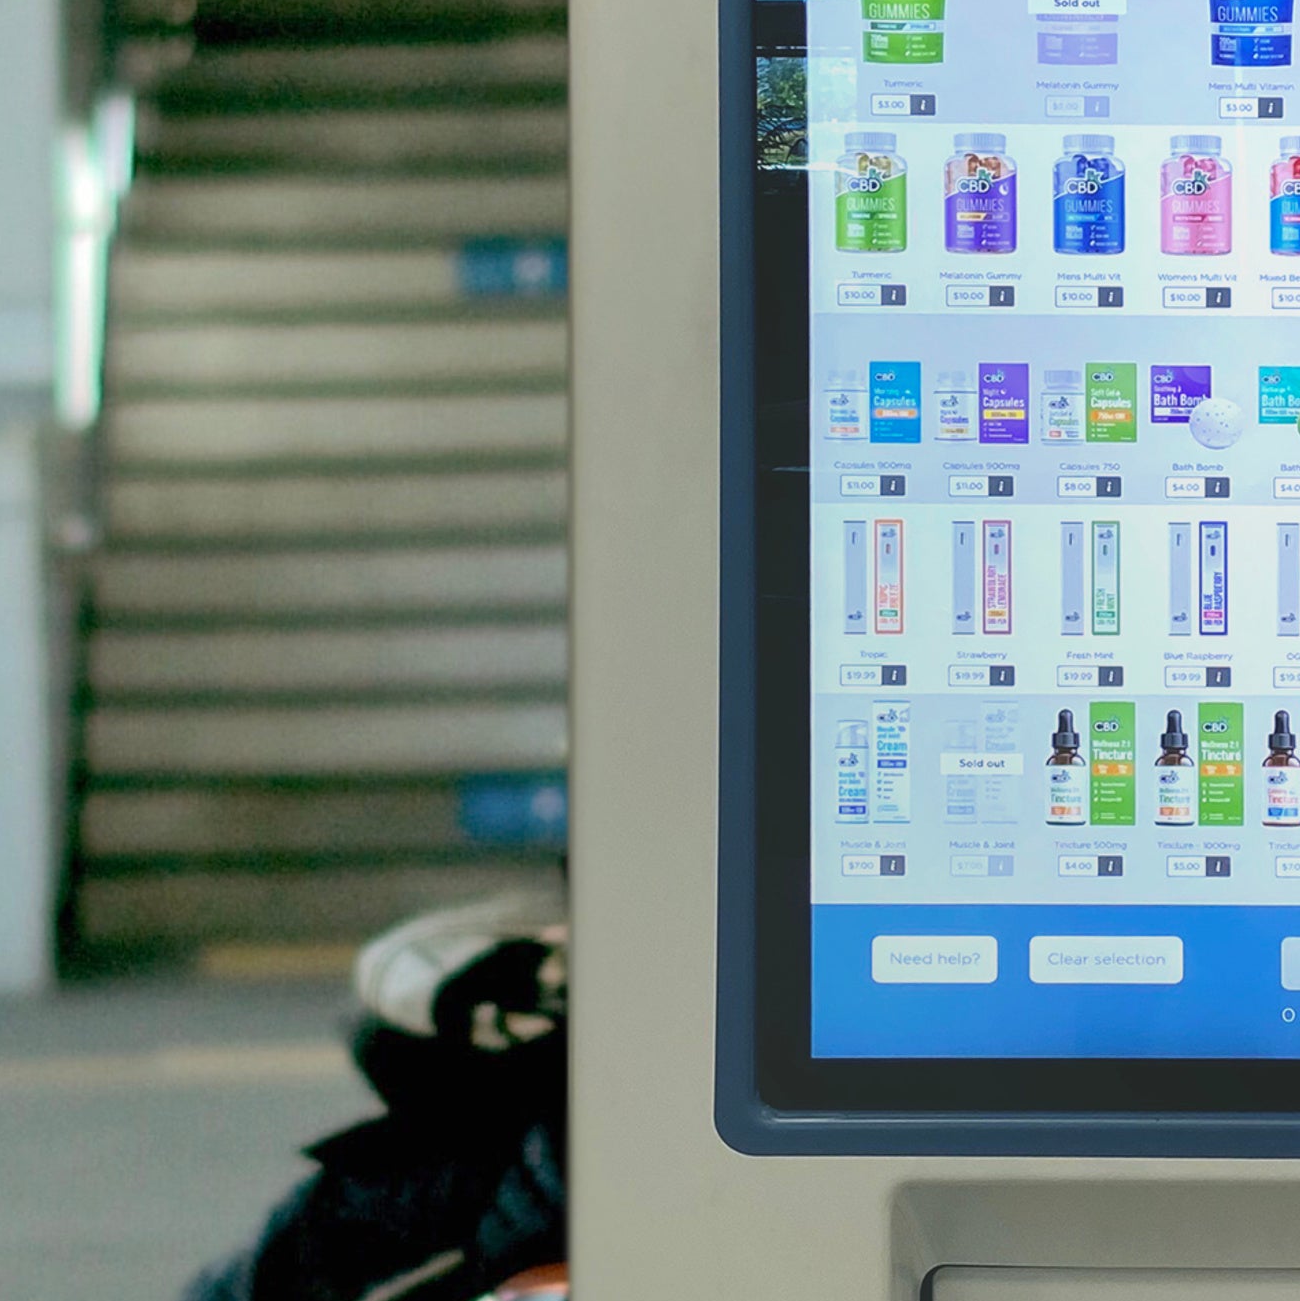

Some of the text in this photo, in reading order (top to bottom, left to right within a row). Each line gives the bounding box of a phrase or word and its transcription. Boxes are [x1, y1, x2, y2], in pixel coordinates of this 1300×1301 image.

[1083, 0, 1100, 7] out
[869, 3, 930, 19] GUMMIES
[1218, 6, 1278, 22] GUMMIES
[960, 759, 1005, 768] Sold out
[890, 952, 980, 967] Need help?
[1048, 953, 1166, 966] Clear selection
